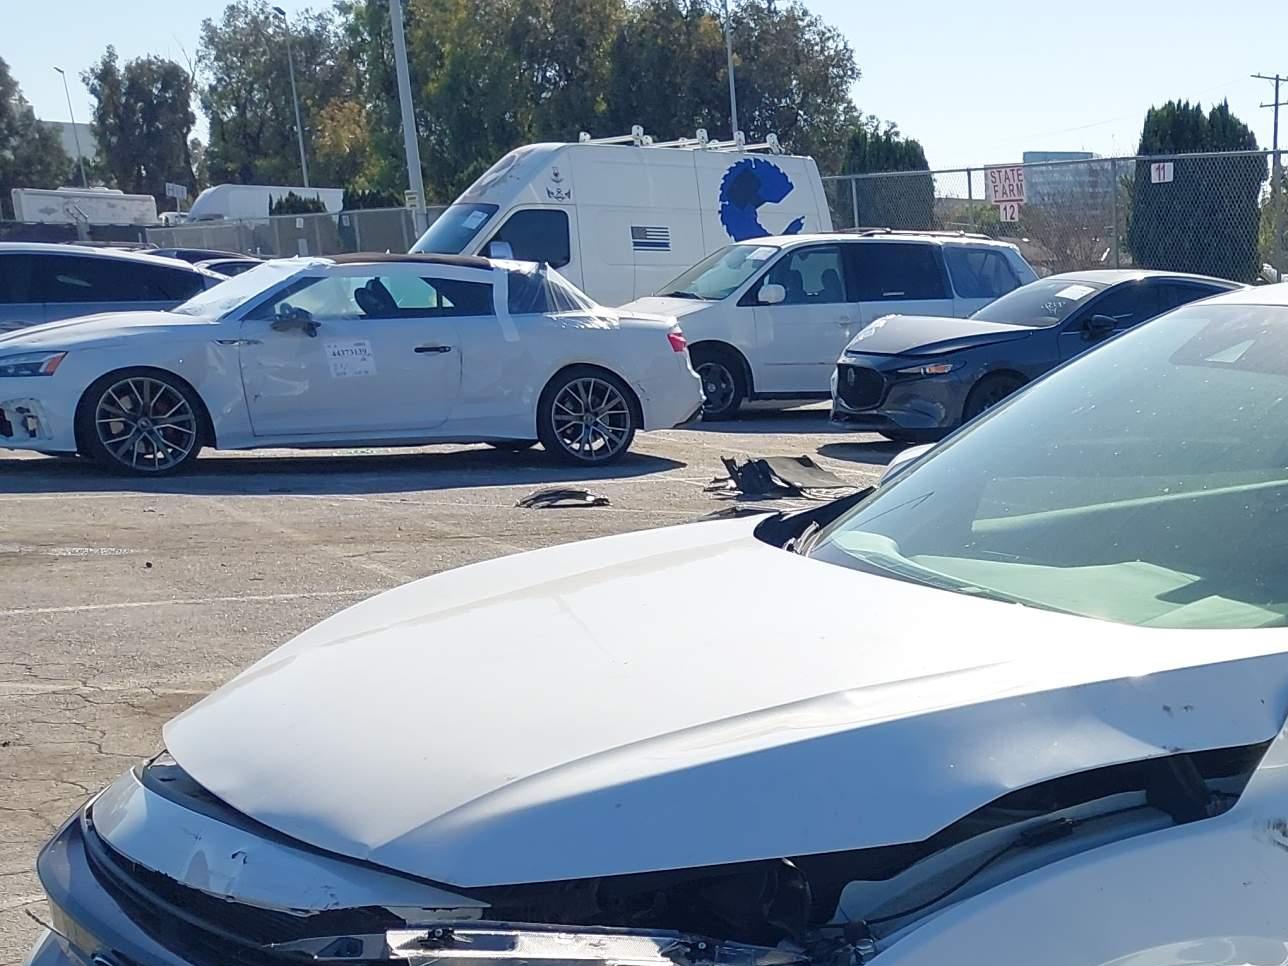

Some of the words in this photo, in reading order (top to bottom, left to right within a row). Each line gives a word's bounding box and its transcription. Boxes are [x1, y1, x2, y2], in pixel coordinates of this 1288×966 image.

[990, 168, 1024, 184] STATE
[1155, 163, 1166, 181] 11
[993, 183, 1024, 199] FARM
[1003, 204, 1016, 221] 12
